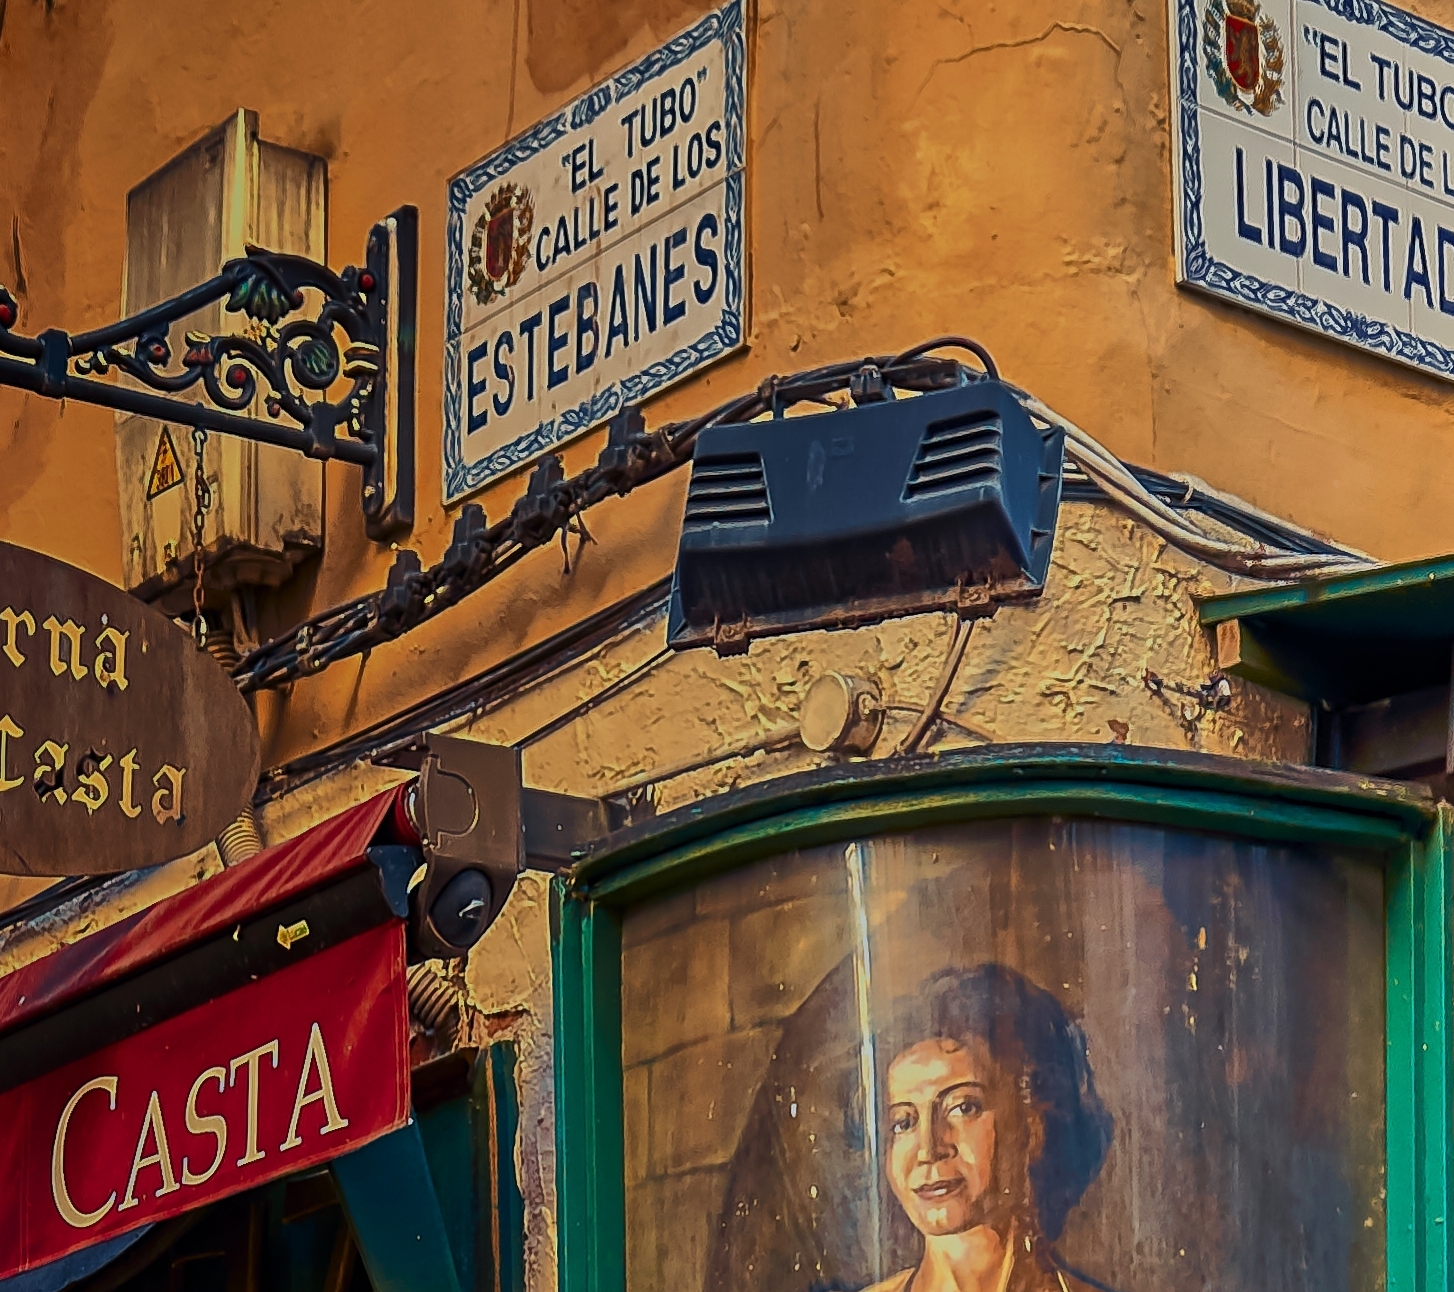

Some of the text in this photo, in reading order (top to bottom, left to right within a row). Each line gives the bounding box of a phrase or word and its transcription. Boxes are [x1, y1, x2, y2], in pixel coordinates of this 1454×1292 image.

[535, 120, 722, 272] CALLE DE LOS
[1306, 96, 1393, 172] CALLE
[1399, 132, 1435, 190] DE
[467, 212, 720, 435] ESTEBANES
[51, 1022, 349, 1231] CASTA
